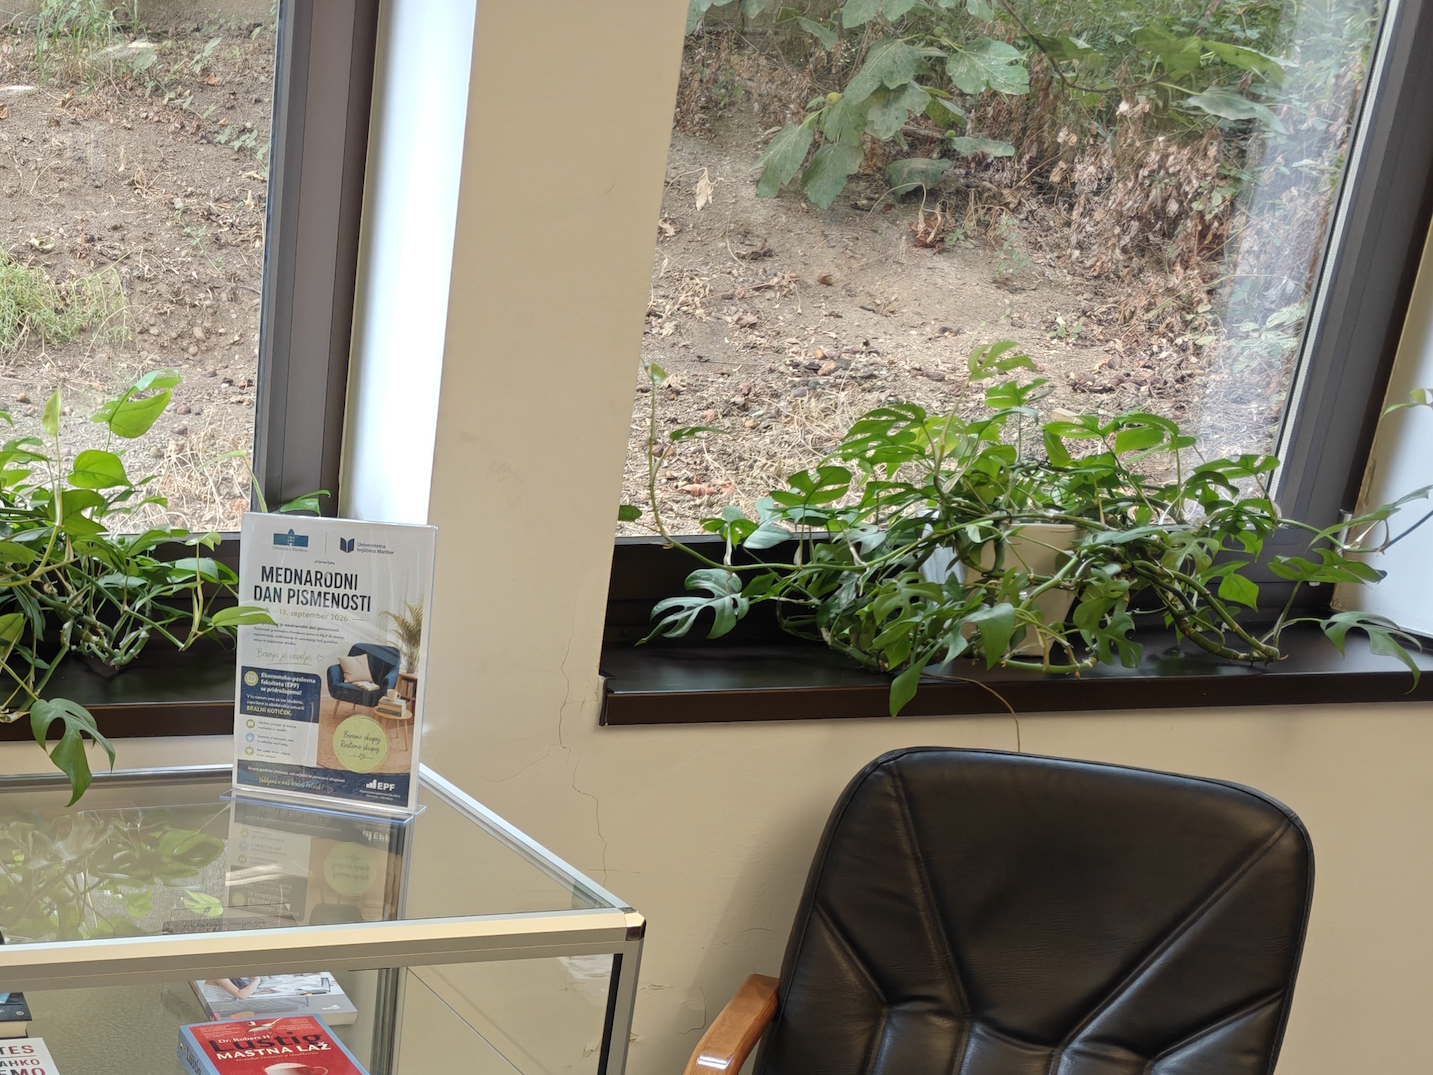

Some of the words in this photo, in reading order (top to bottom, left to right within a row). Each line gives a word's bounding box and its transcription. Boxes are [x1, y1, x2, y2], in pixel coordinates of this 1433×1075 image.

[261, 565, 358, 591] MEDNARODNI
[253, 585, 282, 604] DAN
[287, 588, 371, 612] PISMENOSTI
[279, 608, 289, 616] 13.
[290, 610, 329, 621] september
[330, 613, 349, 621] 2026
[378, 781, 396, 791] EPF
[208, 1031, 322, 1053] Lustig
[216, 1046, 294, 1061] MASTNA
[296, 1041, 332, 1052] LAŽ
